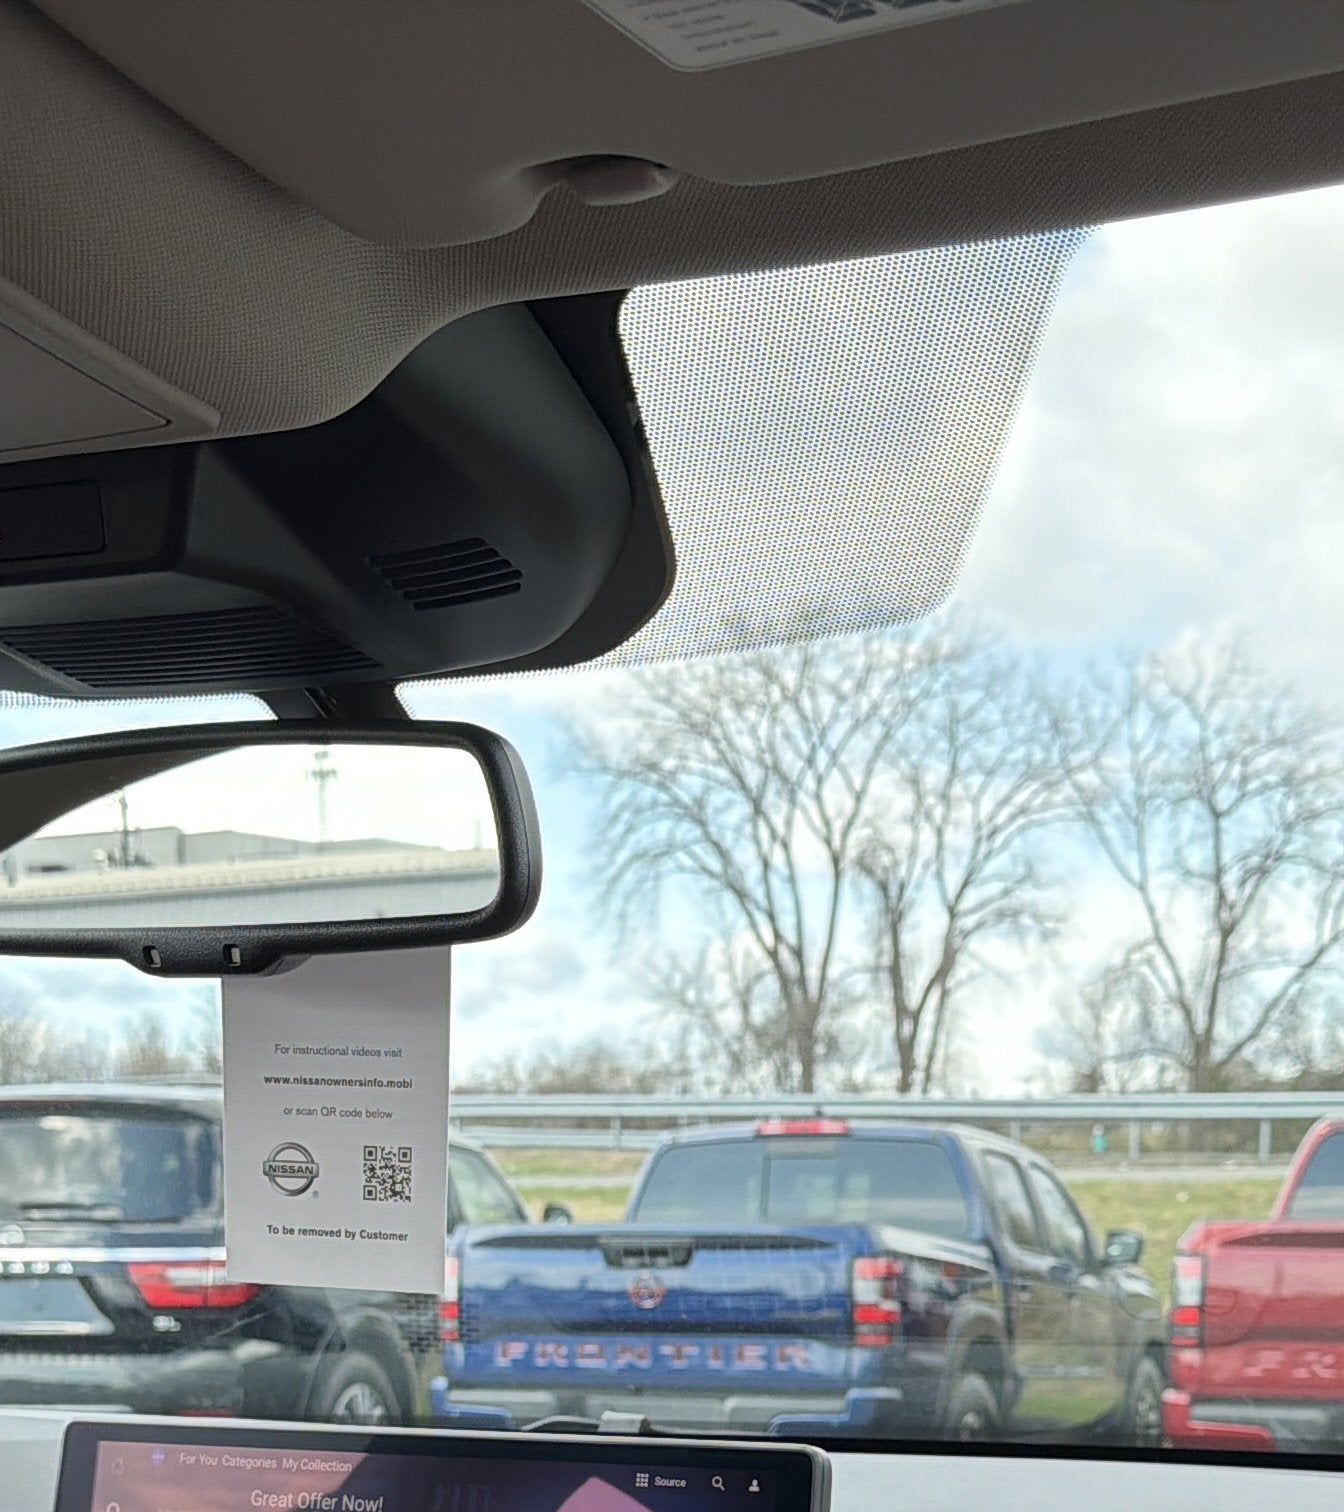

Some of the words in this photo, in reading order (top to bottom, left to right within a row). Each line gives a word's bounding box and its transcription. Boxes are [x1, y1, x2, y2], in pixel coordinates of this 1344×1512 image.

[275, 1045, 289, 1055] For
[293, 1045, 348, 1057] instructional
[351, 1046, 381, 1058] videos
[384, 1048, 402, 1058] visit
[264, 1075, 413, 1090] www.nissanownersinfo.mobi
[283, 1108, 293, 1116] or
[296, 1108, 318, 1117] scan
[321, 1107, 336, 1118] QR
[340, 1108, 362, 1118] code
[366, 1108, 393, 1120] below
[268, 1164, 314, 1175] NISSAN
[267, 1225, 280, 1235] To
[282, 1225, 295, 1235] be
[298, 1226, 341, 1238] removed
[345, 1229, 356, 1240] by
[360, 1230, 408, 1242] Customer
[495, 1341, 814, 1370] FRONTIER
[180, 1453, 196, 1464] For
[199, 1454, 218, 1465] You
[222, 1456, 277, 1470] Categories
[282, 1458, 298, 1472] My
[301, 1458, 352, 1472] Collection
[655, 1476, 686, 1488] Source
[251, 1490, 293, 1508] Great
[297, 1492, 336, 1511] Offer
[342, 1494, 384, 1512] Now!
